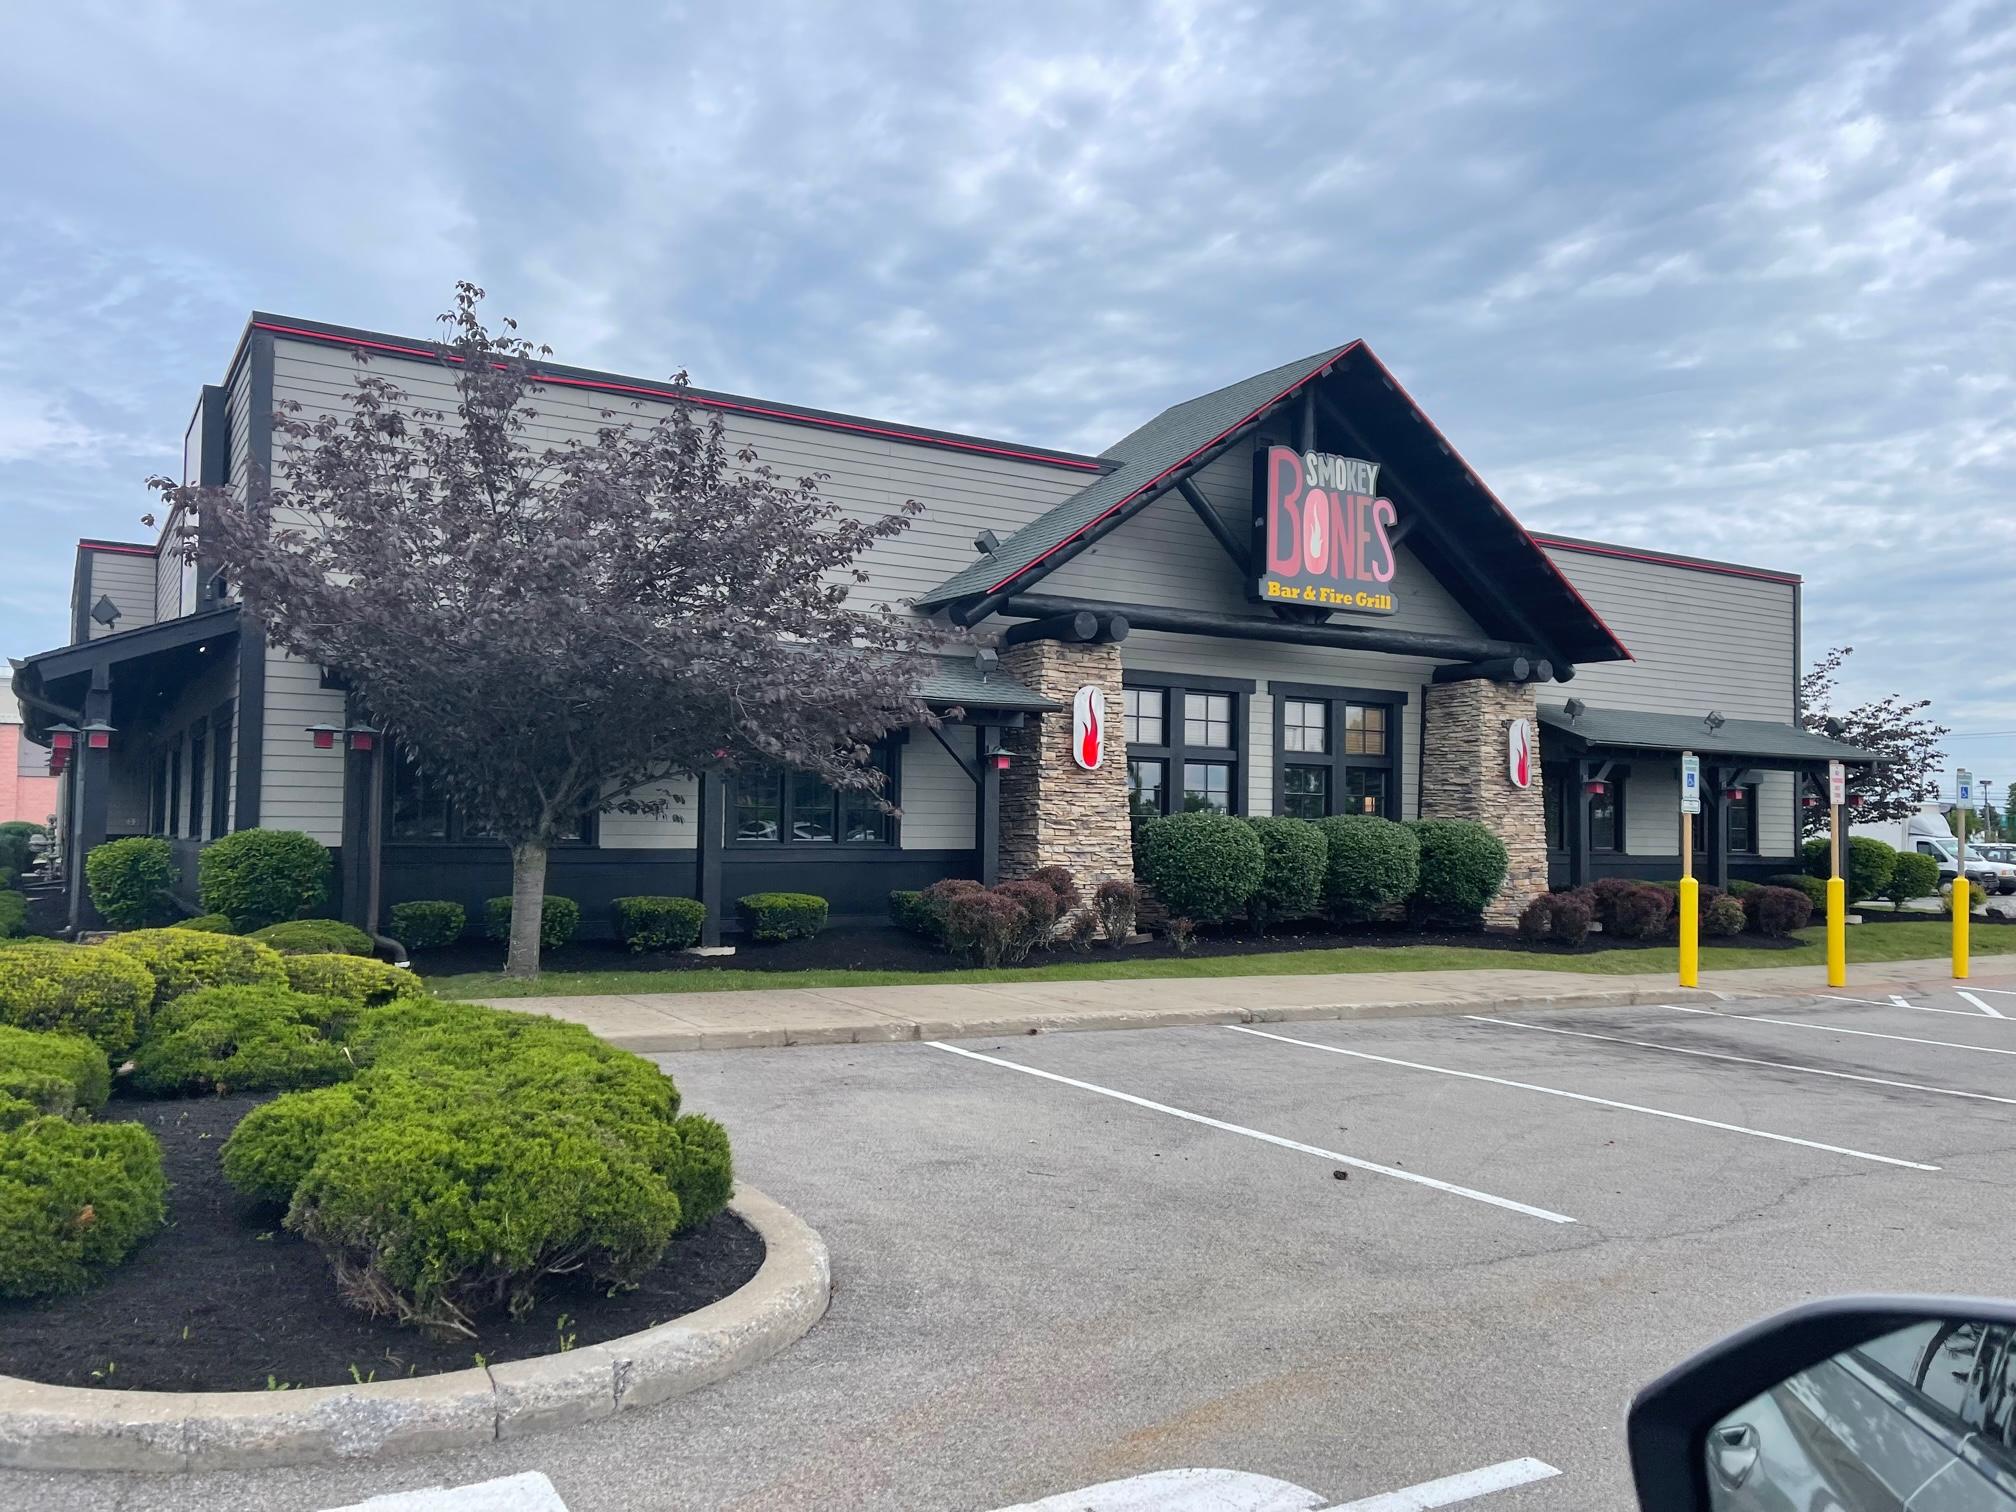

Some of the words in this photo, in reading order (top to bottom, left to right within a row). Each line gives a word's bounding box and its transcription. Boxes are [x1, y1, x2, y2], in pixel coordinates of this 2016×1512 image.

[1306, 452, 1378, 495] SMOKEY
[1268, 447, 1396, 583] BONES
[1267, 581, 1300, 598] Bar
[1303, 585, 1316, 601] &
[1319, 587, 1353, 605] Fire
[1355, 591, 1393, 610] Grill
